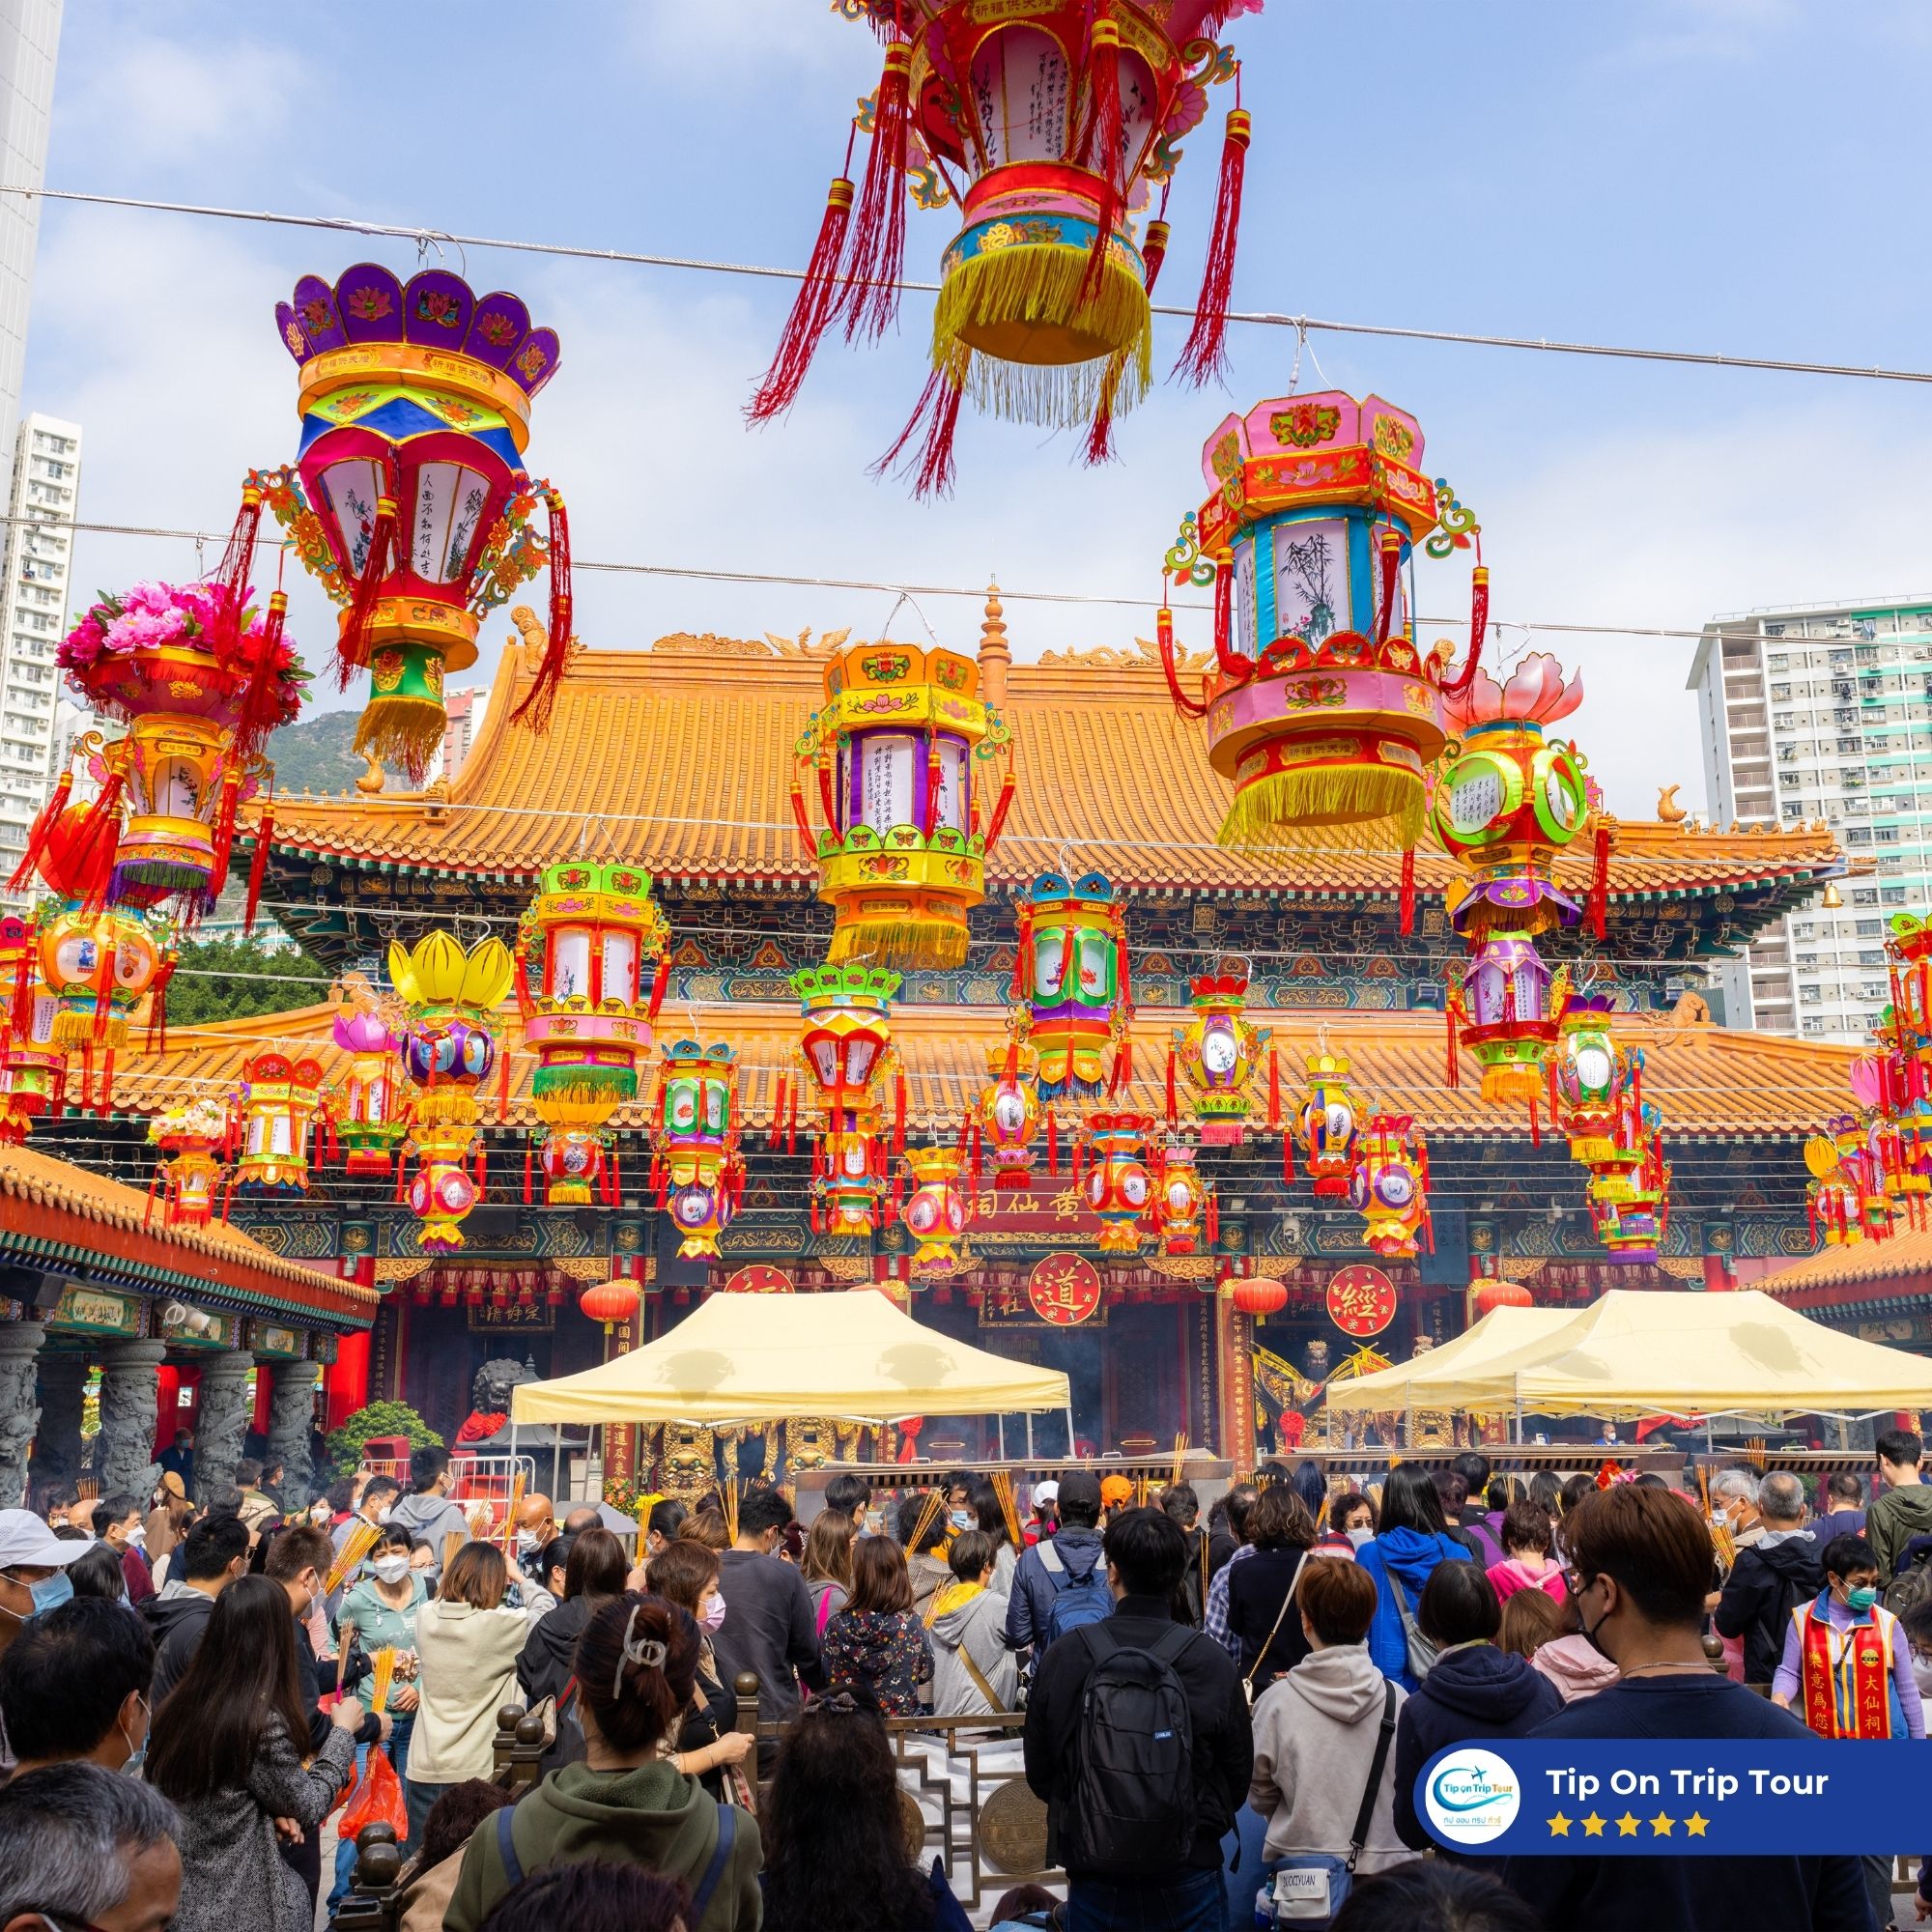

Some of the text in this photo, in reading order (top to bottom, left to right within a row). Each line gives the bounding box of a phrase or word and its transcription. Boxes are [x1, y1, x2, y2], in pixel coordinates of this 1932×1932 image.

[1043, 1266, 1085, 1311] 道
[1341, 1282, 1378, 1319] 經
[1863, 1674, 1881, 1739] 大仙祠
